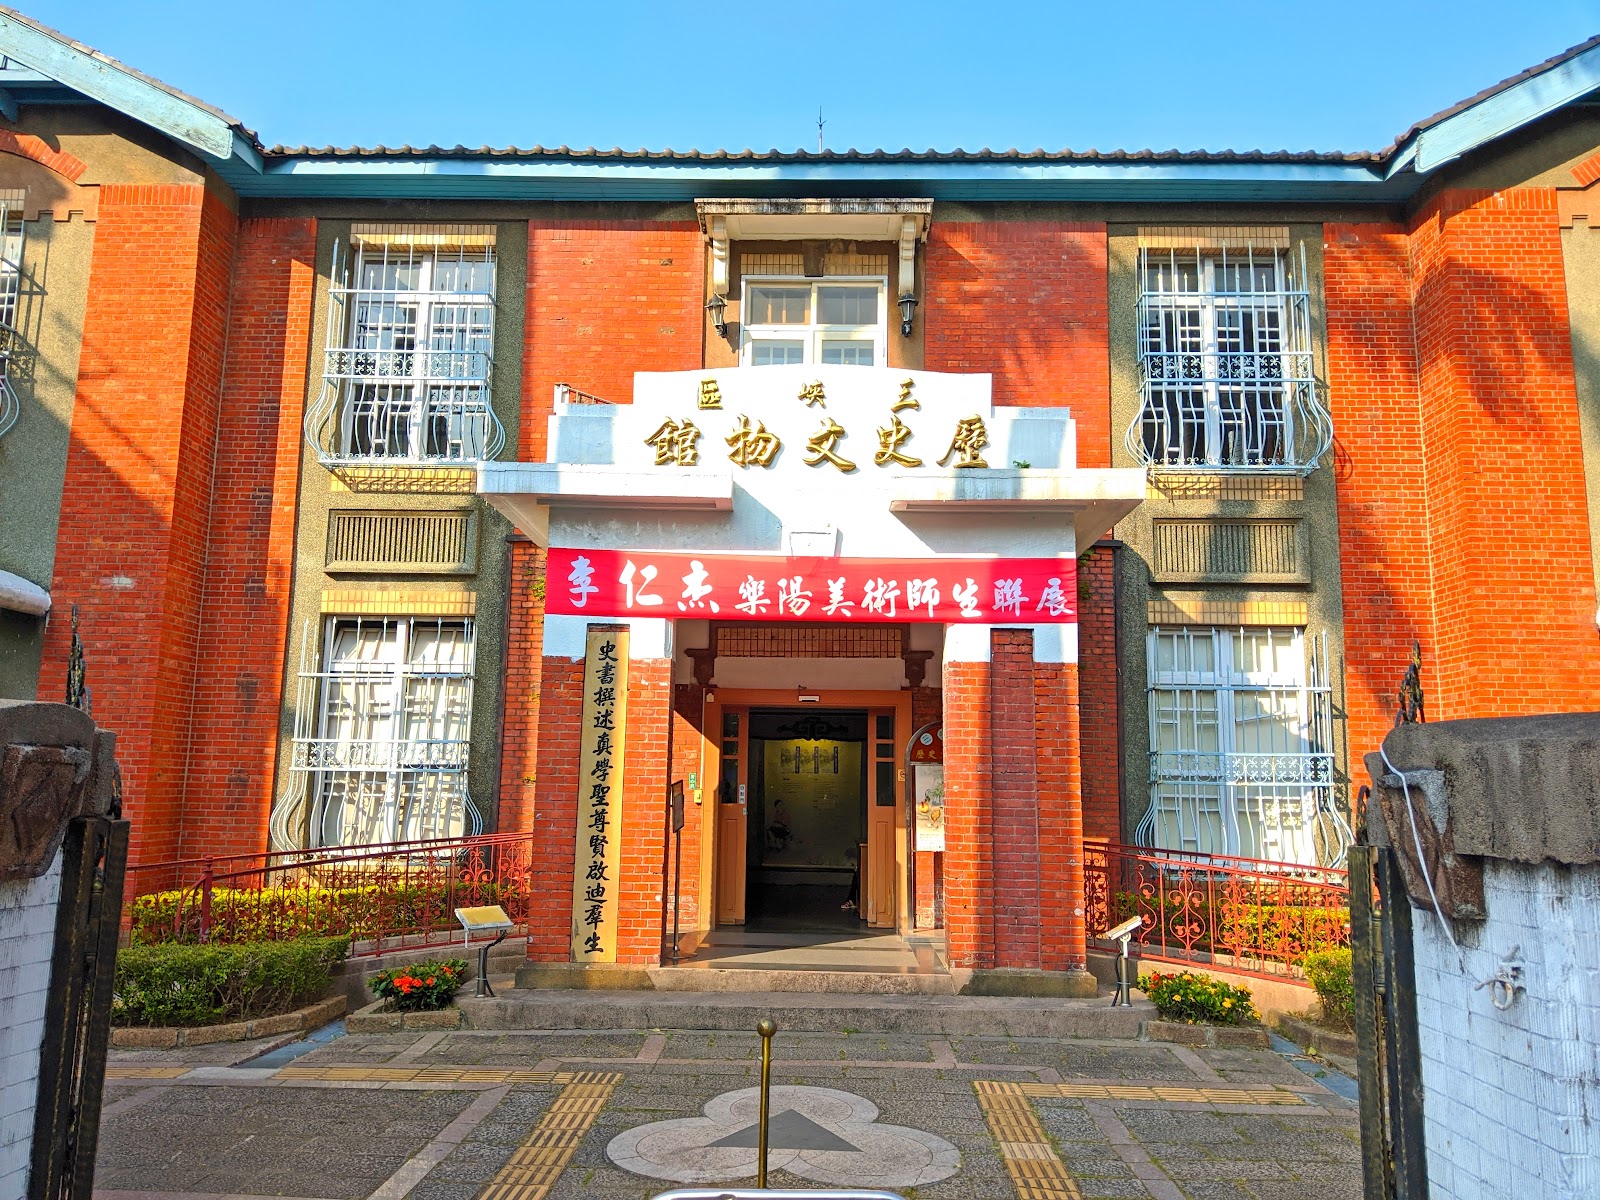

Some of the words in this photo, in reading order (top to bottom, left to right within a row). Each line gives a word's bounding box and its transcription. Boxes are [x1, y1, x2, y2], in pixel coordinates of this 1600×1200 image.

[698, 376, 920, 412] 三峽區
[644, 413, 989, 471] 歷史文物館
[916, 749, 942, 759] 歷史
